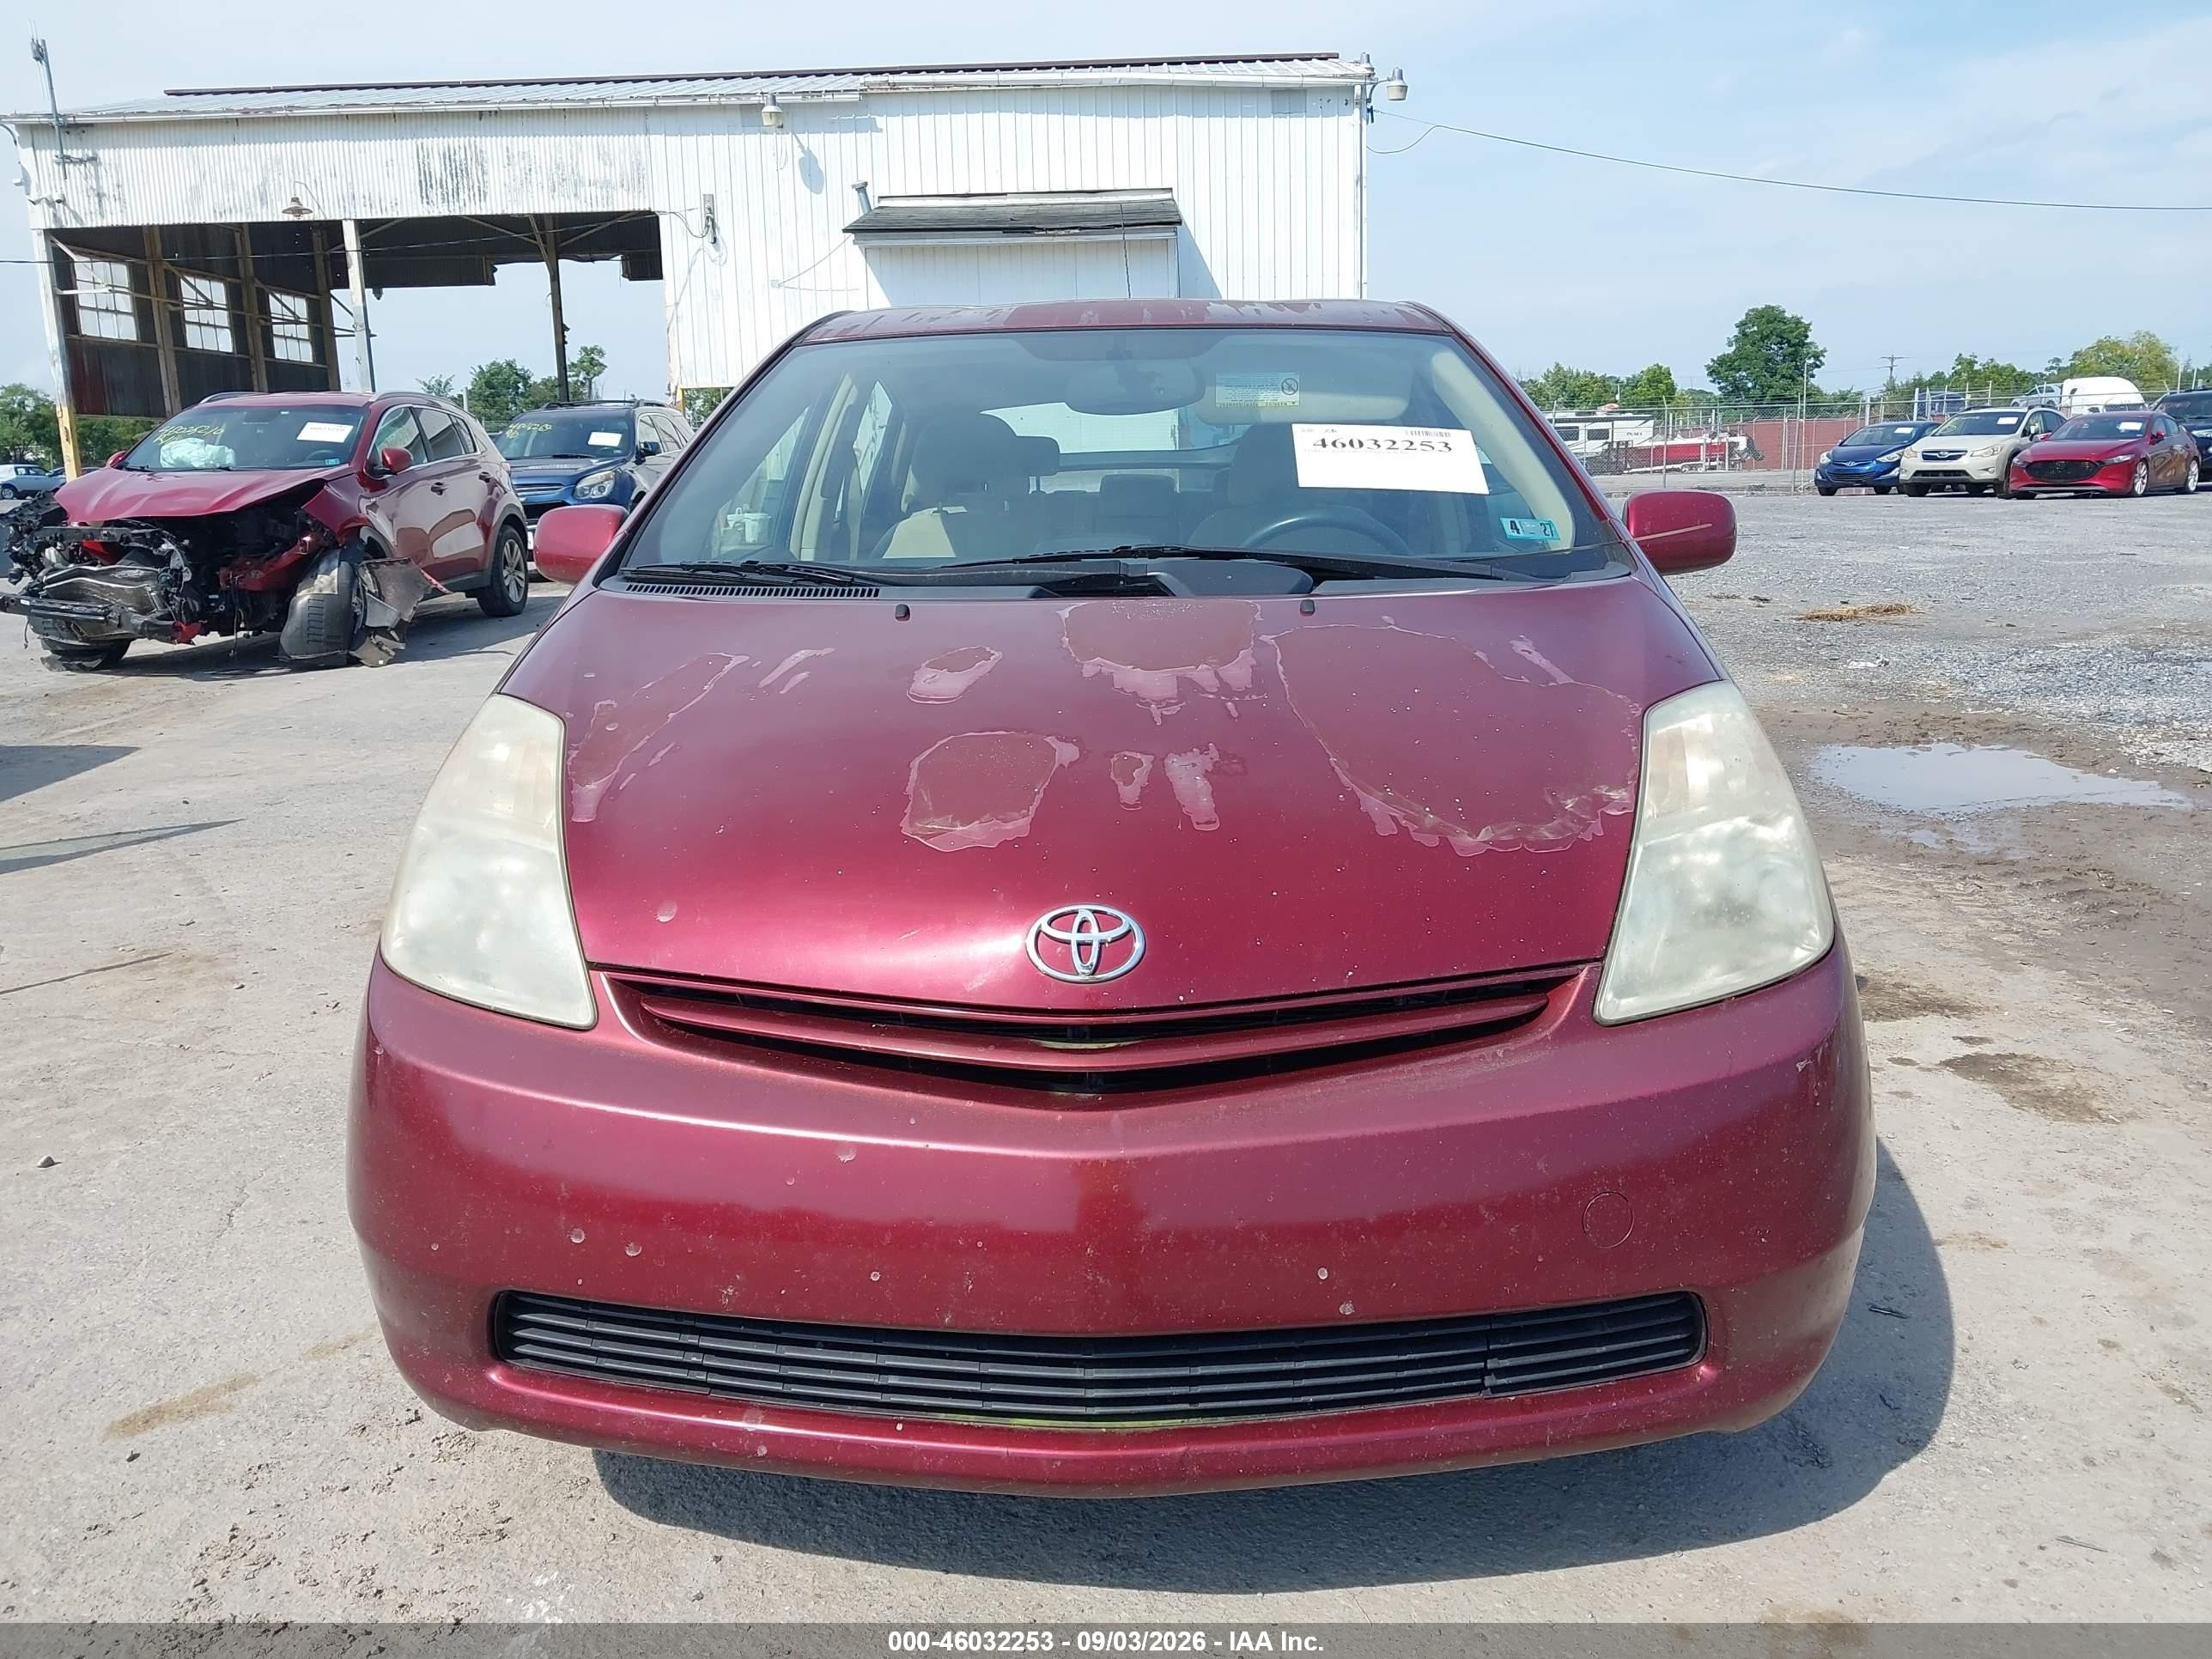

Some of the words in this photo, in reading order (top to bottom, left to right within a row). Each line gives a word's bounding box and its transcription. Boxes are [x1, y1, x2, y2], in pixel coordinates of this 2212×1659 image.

[1312, 437, 1453, 453] 46032253
[1510, 520, 1521, 534] 4
[1540, 522, 1554, 537] 27
